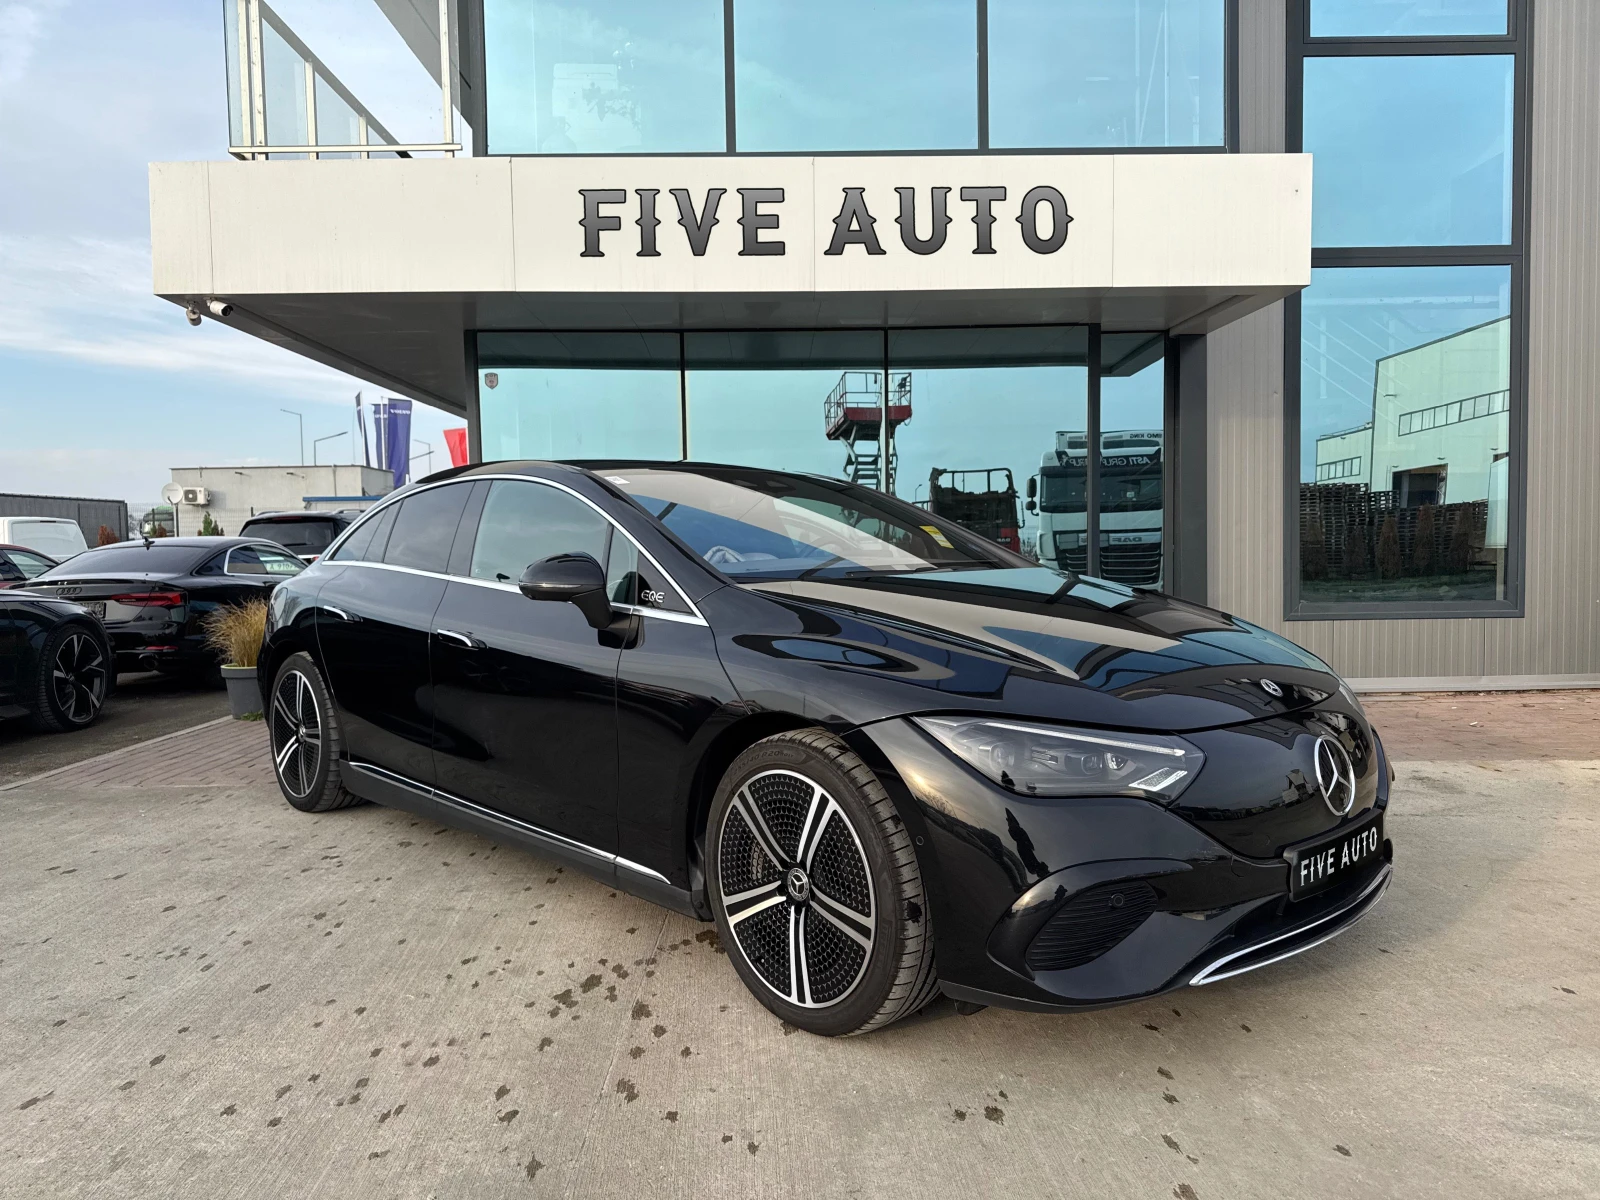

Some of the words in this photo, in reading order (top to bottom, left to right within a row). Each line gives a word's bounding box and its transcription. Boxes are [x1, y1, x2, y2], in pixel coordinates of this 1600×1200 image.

[578, 188, 786, 257] FIVE
[823, 186, 1075, 256] AUTO
[641, 589, 665, 603] EQE
[1300, 847, 1336, 887] FIVE
[1340, 826, 1378, 869] AUTO
